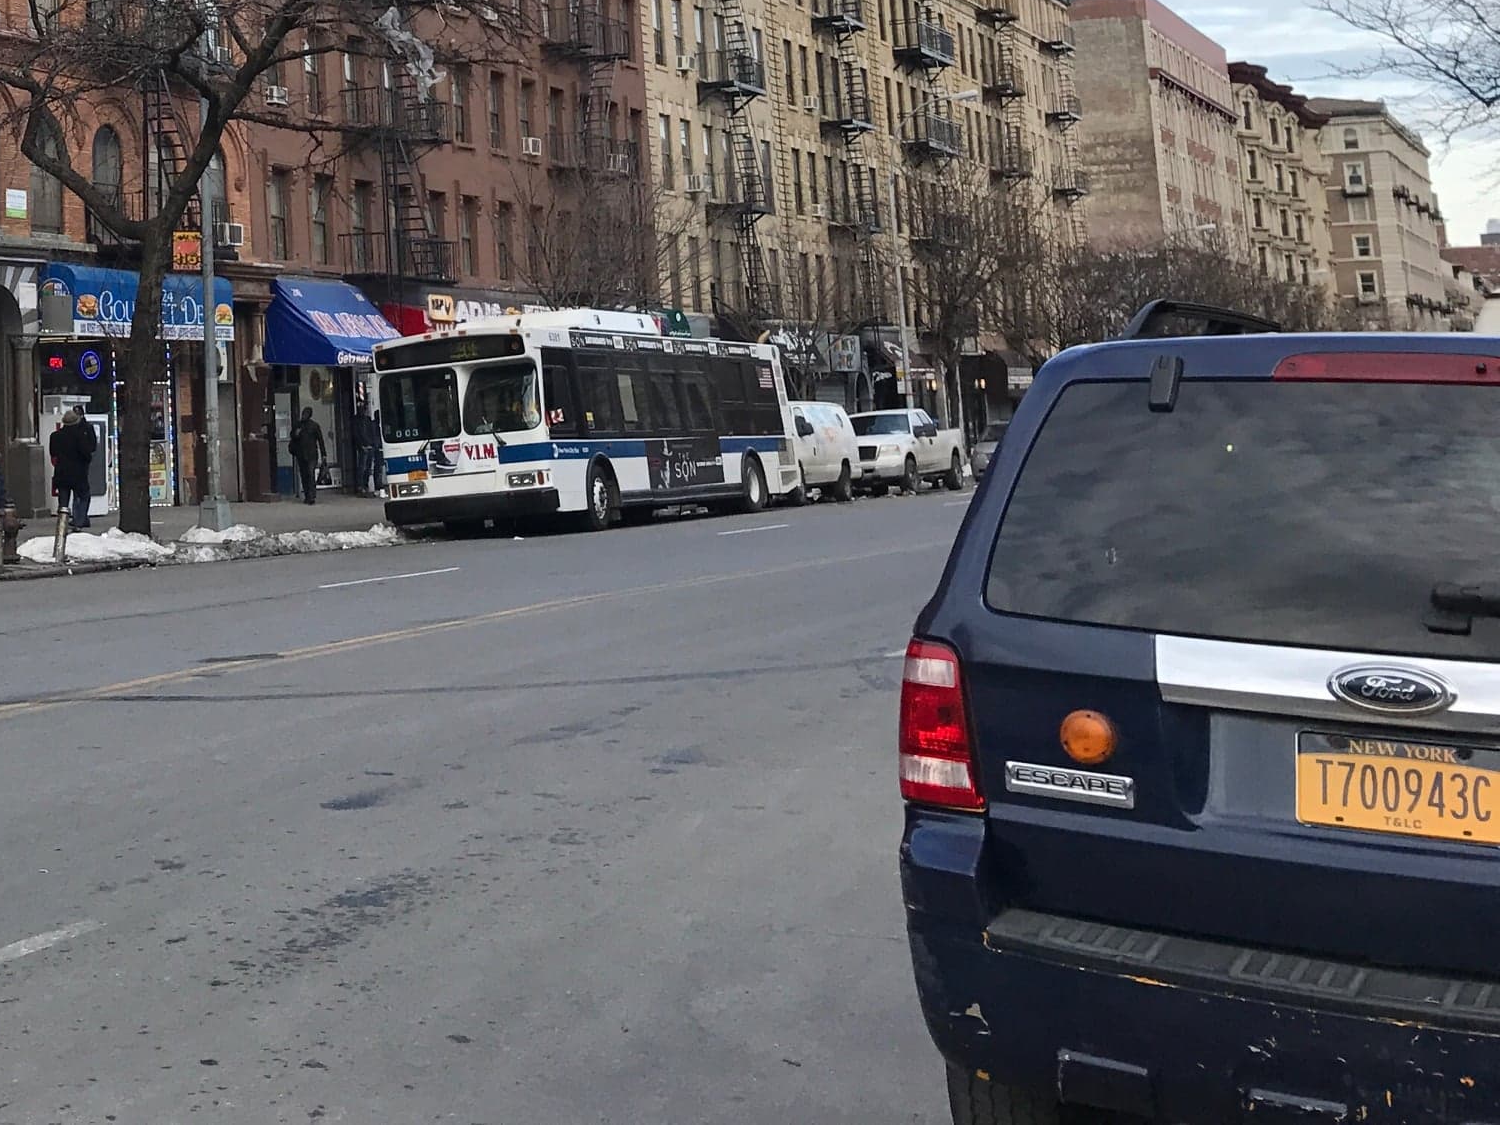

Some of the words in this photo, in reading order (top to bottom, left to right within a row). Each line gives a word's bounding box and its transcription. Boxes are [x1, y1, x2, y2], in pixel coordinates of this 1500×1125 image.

[180, 295, 204, 326] DE
[674, 460, 697, 482] SON
[1360, 676, 1416, 701] Ford
[1349, 739, 1399, 757] NEW
[1404, 746, 1457, 764] YORK
[1015, 767, 1126, 795] ESCAPE
[1315, 758, 1492, 823] T700943C
[1384, 816, 1423, 829] T&LC
